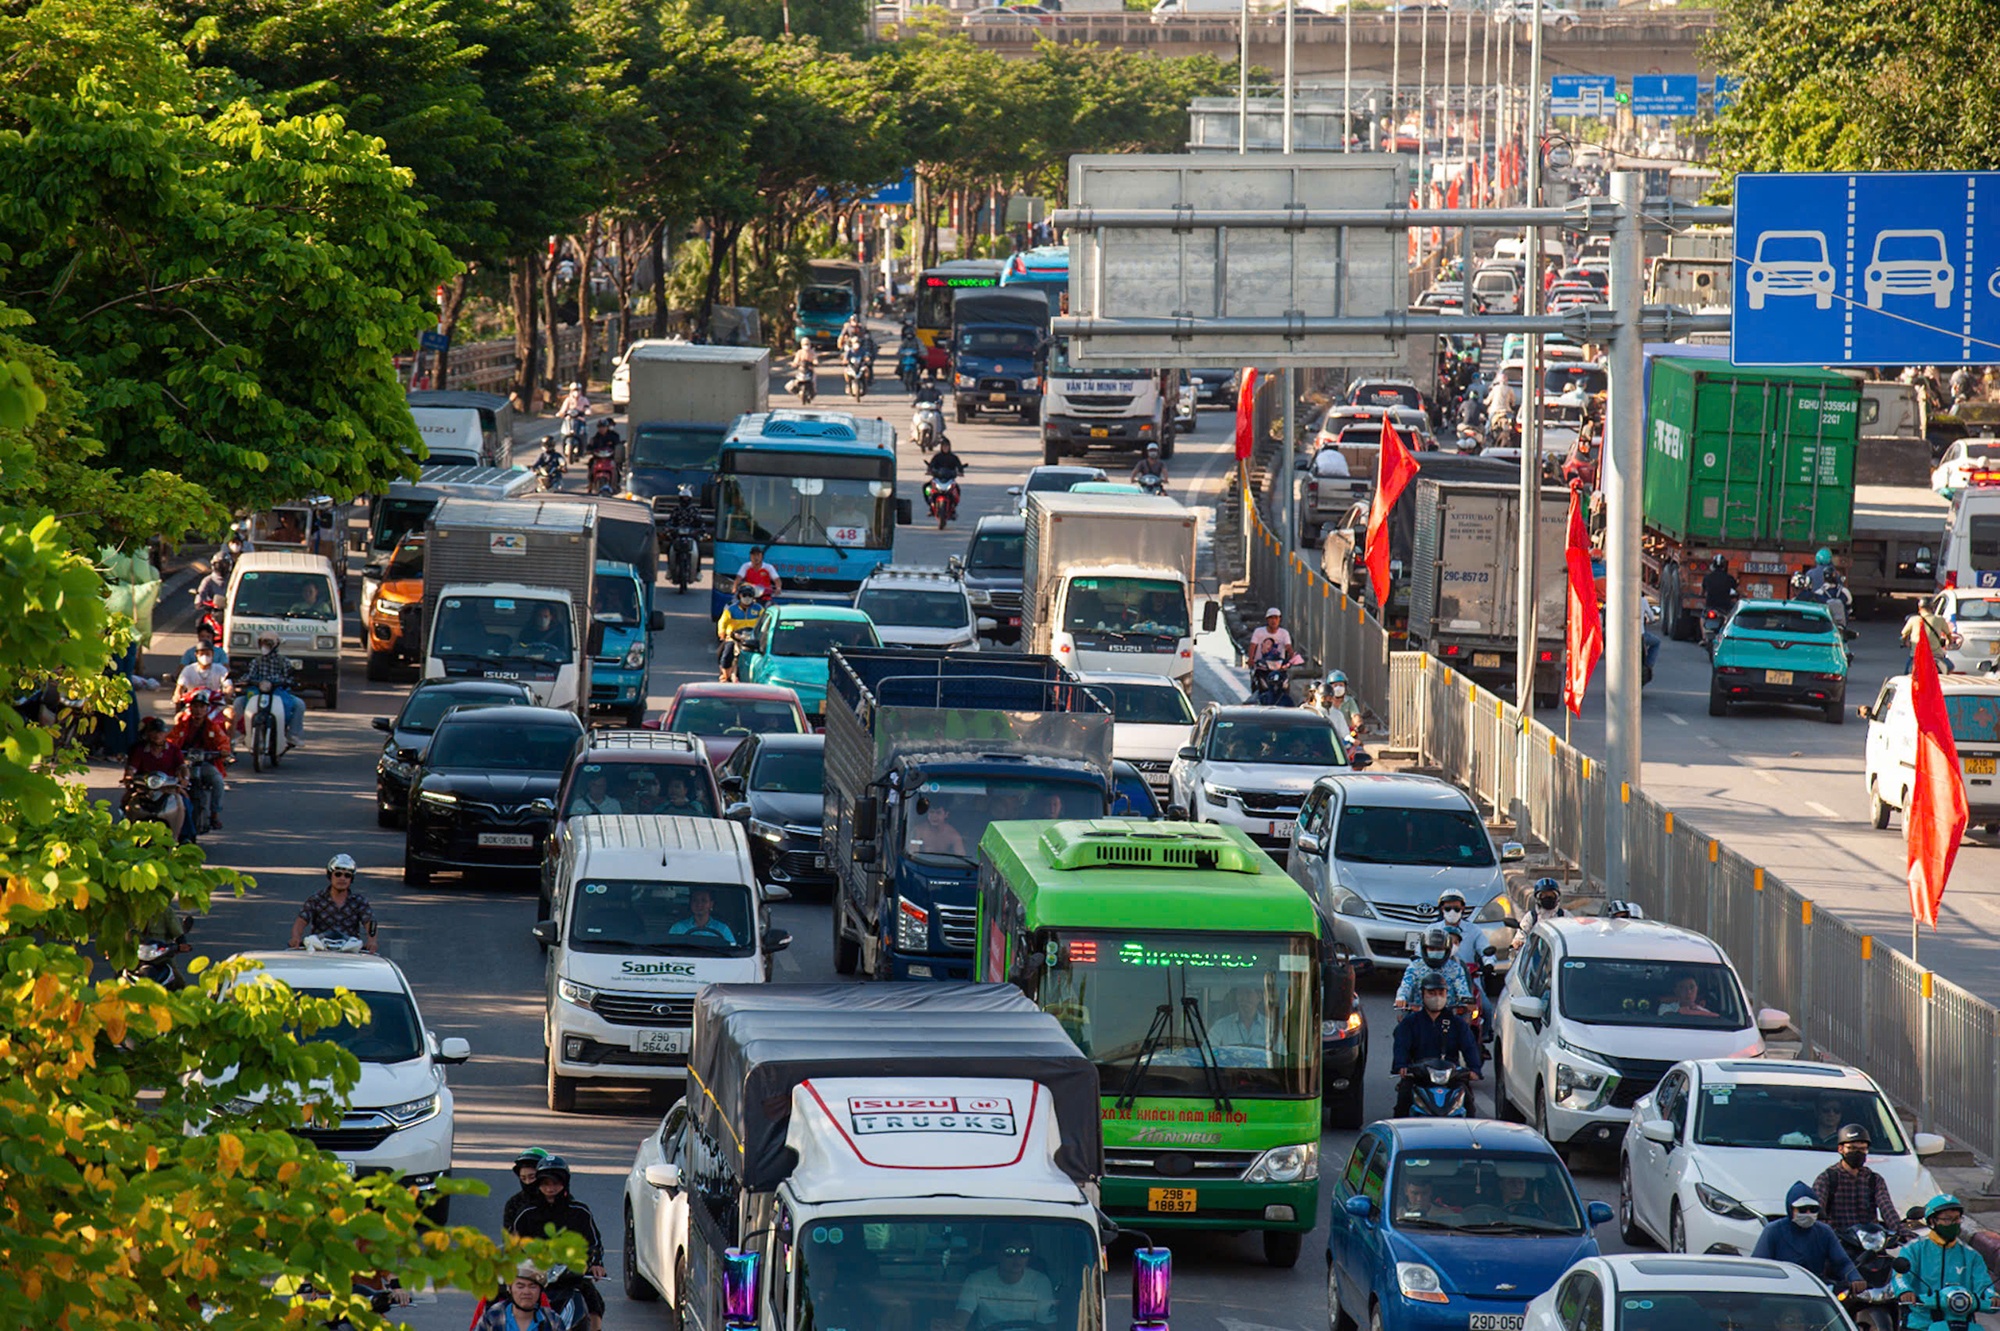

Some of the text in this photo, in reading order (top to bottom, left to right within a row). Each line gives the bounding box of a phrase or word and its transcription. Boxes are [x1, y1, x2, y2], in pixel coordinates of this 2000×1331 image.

[1096, 381, 1117, 391] MINH
[1799, 399, 1820, 410] EGHU
[1822, 413, 1840, 424] 22G1
[835, 528, 857, 541] 48
[1108, 644, 1142, 652] ISUZU
[483, 671, 519, 680] ISUZU
[621, 960, 696, 976] Sanitec
[1101, 1109, 1115, 1119] XN
[1119, 1109, 1131, 1119] XE
[1137, 1107, 1175, 1121] KHÁCH
[1179, 1111, 1204, 1122] NAM
[1226, 1110, 1247, 1126] NỘI
[861, 1117, 1006, 1129] TRUCKS
[1162, 1189, 1183, 1200] 29B
[1155, 1200, 1192, 1211] 188.97
